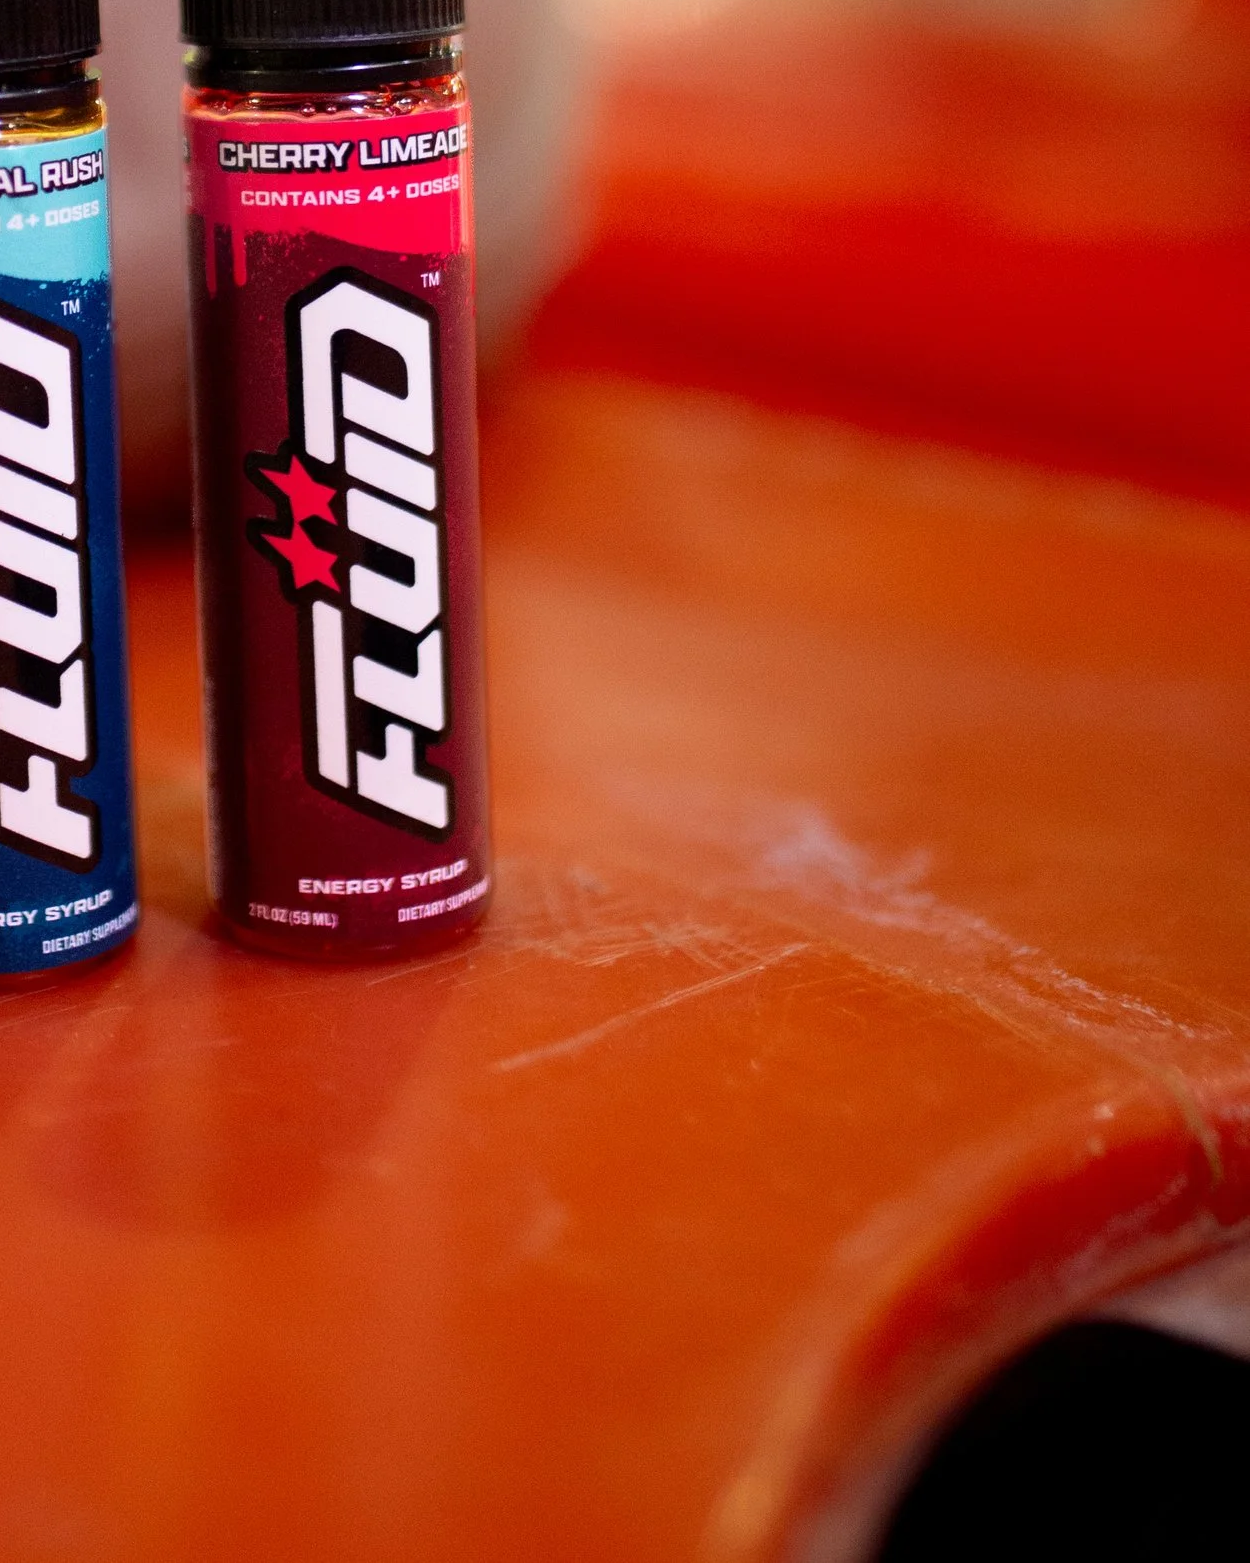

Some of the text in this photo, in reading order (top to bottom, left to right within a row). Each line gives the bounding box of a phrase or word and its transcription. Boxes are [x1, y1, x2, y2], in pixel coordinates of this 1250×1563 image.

[218, 141, 354, 174] CHERRY
[359, 124, 468, 169] LIMEADE
[41, 149, 104, 192] RUSH
[241, 173, 459, 207] CONTAINS 4+ DOSES
[6, 213, 40, 231] 4+
[45, 200, 99, 227] DOSES
[421, 271, 441, 288] TM
[61, 298, 80, 316] TM
[299, 281, 448, 829] FLUID
[298, 858, 468, 895] ENERGY SYRUP
[45, 888, 114, 922] SYRUP
[249, 903, 339, 929] 2 FL OZ (59 ML)
[398, 899, 447, 923] DIETARY
[42, 929, 91, 955] DIETARY
